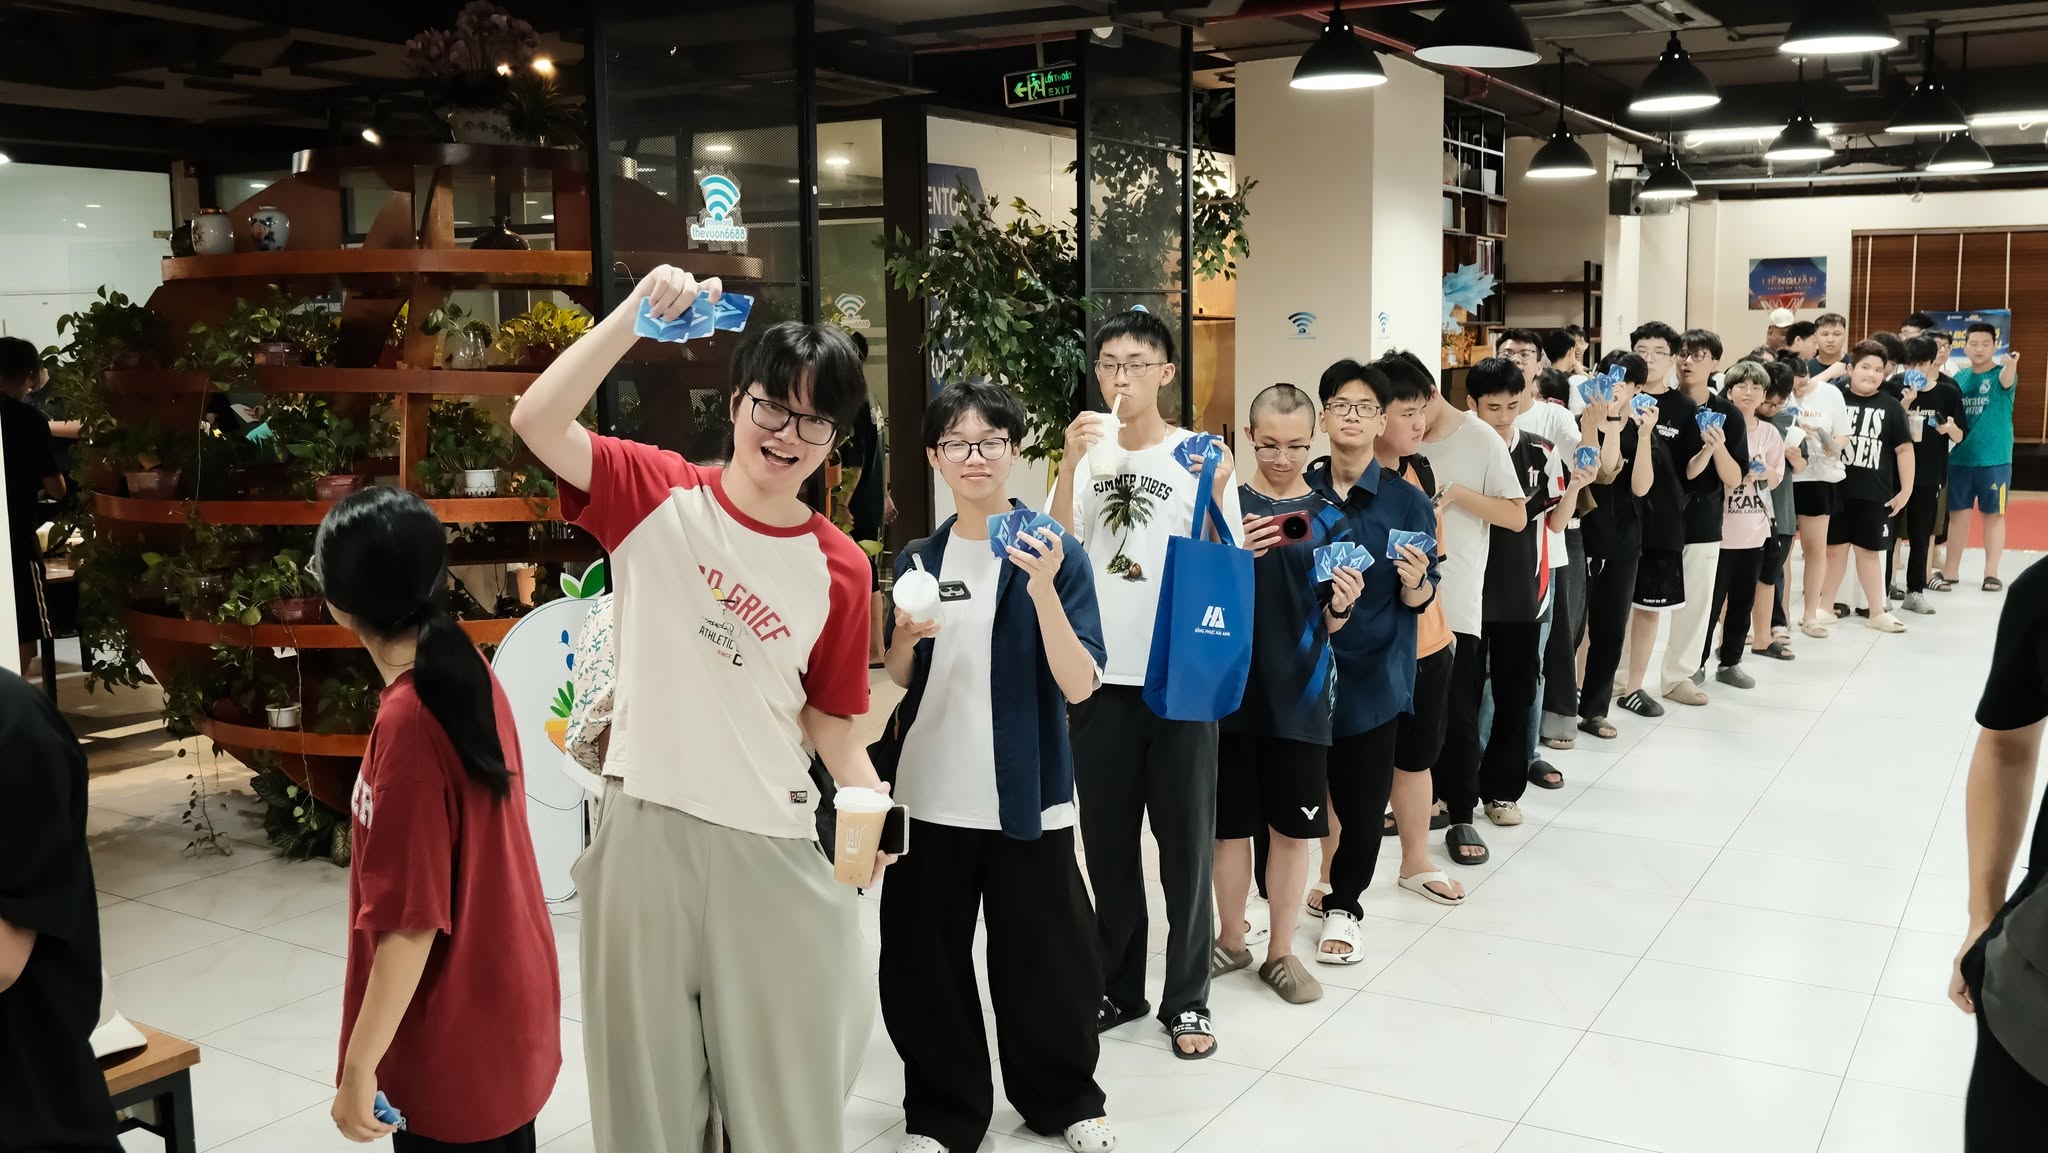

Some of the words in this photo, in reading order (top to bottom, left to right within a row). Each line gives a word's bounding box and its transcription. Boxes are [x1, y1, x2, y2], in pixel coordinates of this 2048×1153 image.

[1048, 85, 1071, 96] EXIT
[692, 228, 745, 239] thevuon6688
[1859, 407, 1885, 439] IS
[1140, 475, 1173, 500] VIBES
[724, 583, 791, 641] GRIEF
[699, 625, 734, 650] ATHLETIC
